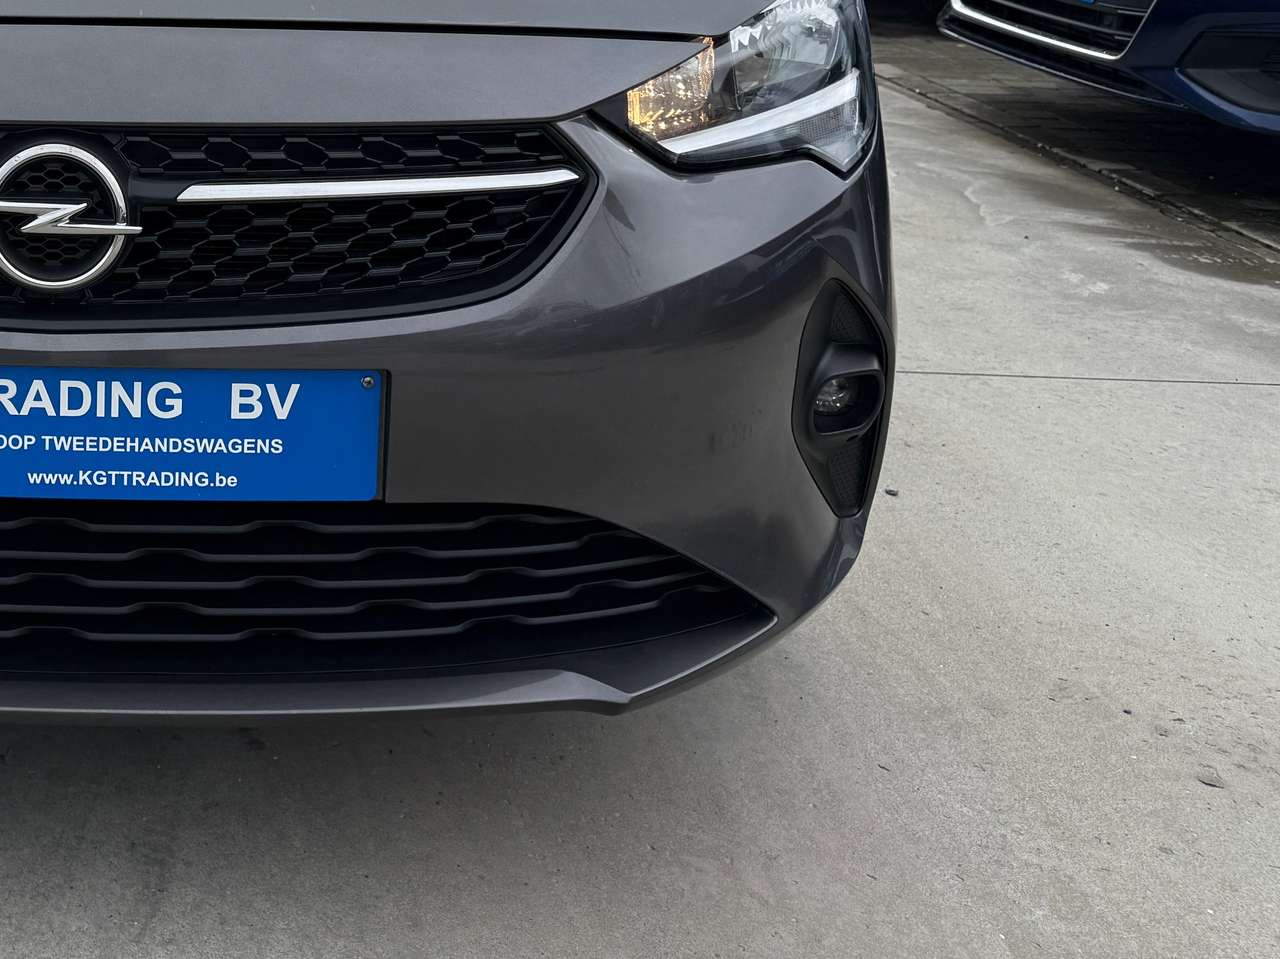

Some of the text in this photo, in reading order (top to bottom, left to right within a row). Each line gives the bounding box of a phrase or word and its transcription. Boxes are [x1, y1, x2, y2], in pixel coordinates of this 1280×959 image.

[230, 383, 301, 420] BV
[41, 435, 283, 454] TWEEDEHANDSWAGENS
[27, 470, 238, 487] www.KGTTRADING.be
